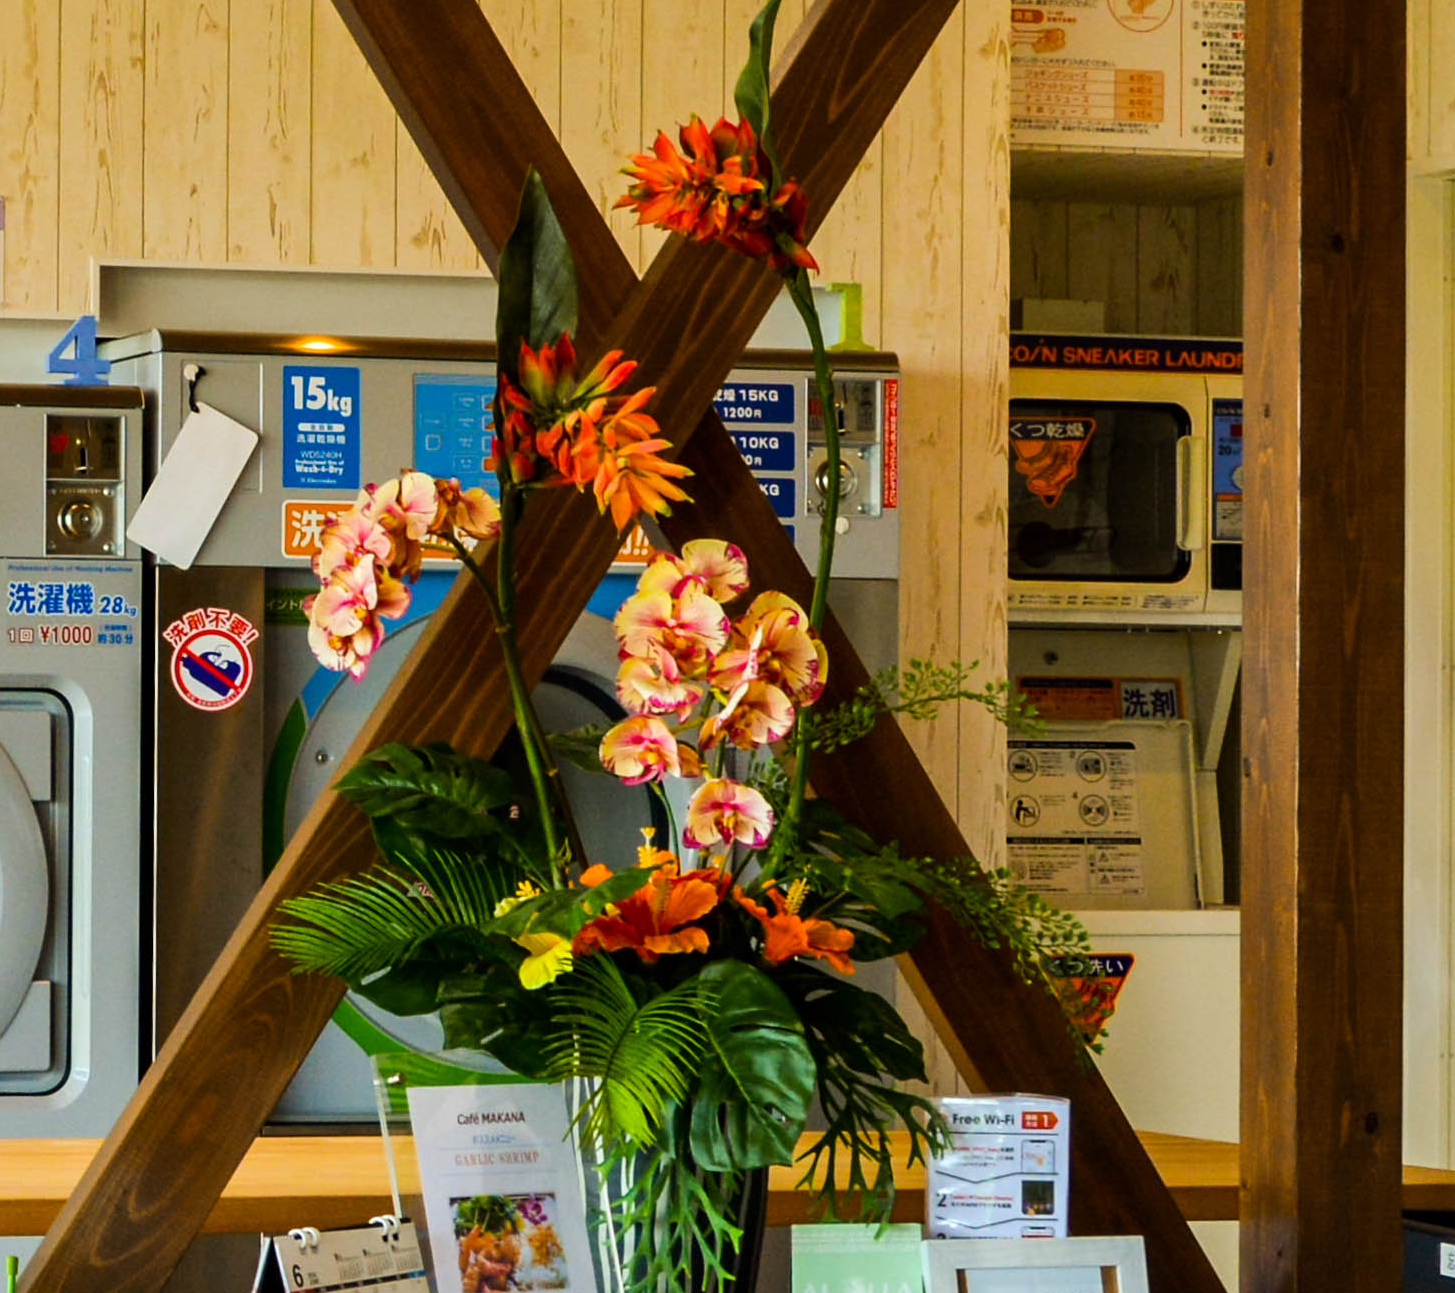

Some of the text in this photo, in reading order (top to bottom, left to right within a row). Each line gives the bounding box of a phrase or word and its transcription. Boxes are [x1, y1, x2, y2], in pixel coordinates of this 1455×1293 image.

[825, 283, 876, 351] 1
[45, 315, 111, 386] 4
[1063, 346, 1159, 366] SNEAKER
[291, 376, 352, 417] 15kg
[739, 389, 779, 402] 15KG
[1009, 422, 1084, 438] くつ乾燥
[741, 437, 779, 449] 10KG
[8, 582, 137, 617] 洗濯機 28kg
[41, 625, 92, 644] ¥1000
[163, 607, 259, 646] 洗剤不要!
[1123, 687, 1176, 718] 洗剤
[457, 1111, 525, 1126] Café MAKANA
[952, 1114, 980, 1125] Free
[985, 1114, 1015, 1125] Wi-Fi
[454, 1151, 540, 1167] GARLIC SHRIMP
[292, 1265, 304, 1288] 6
